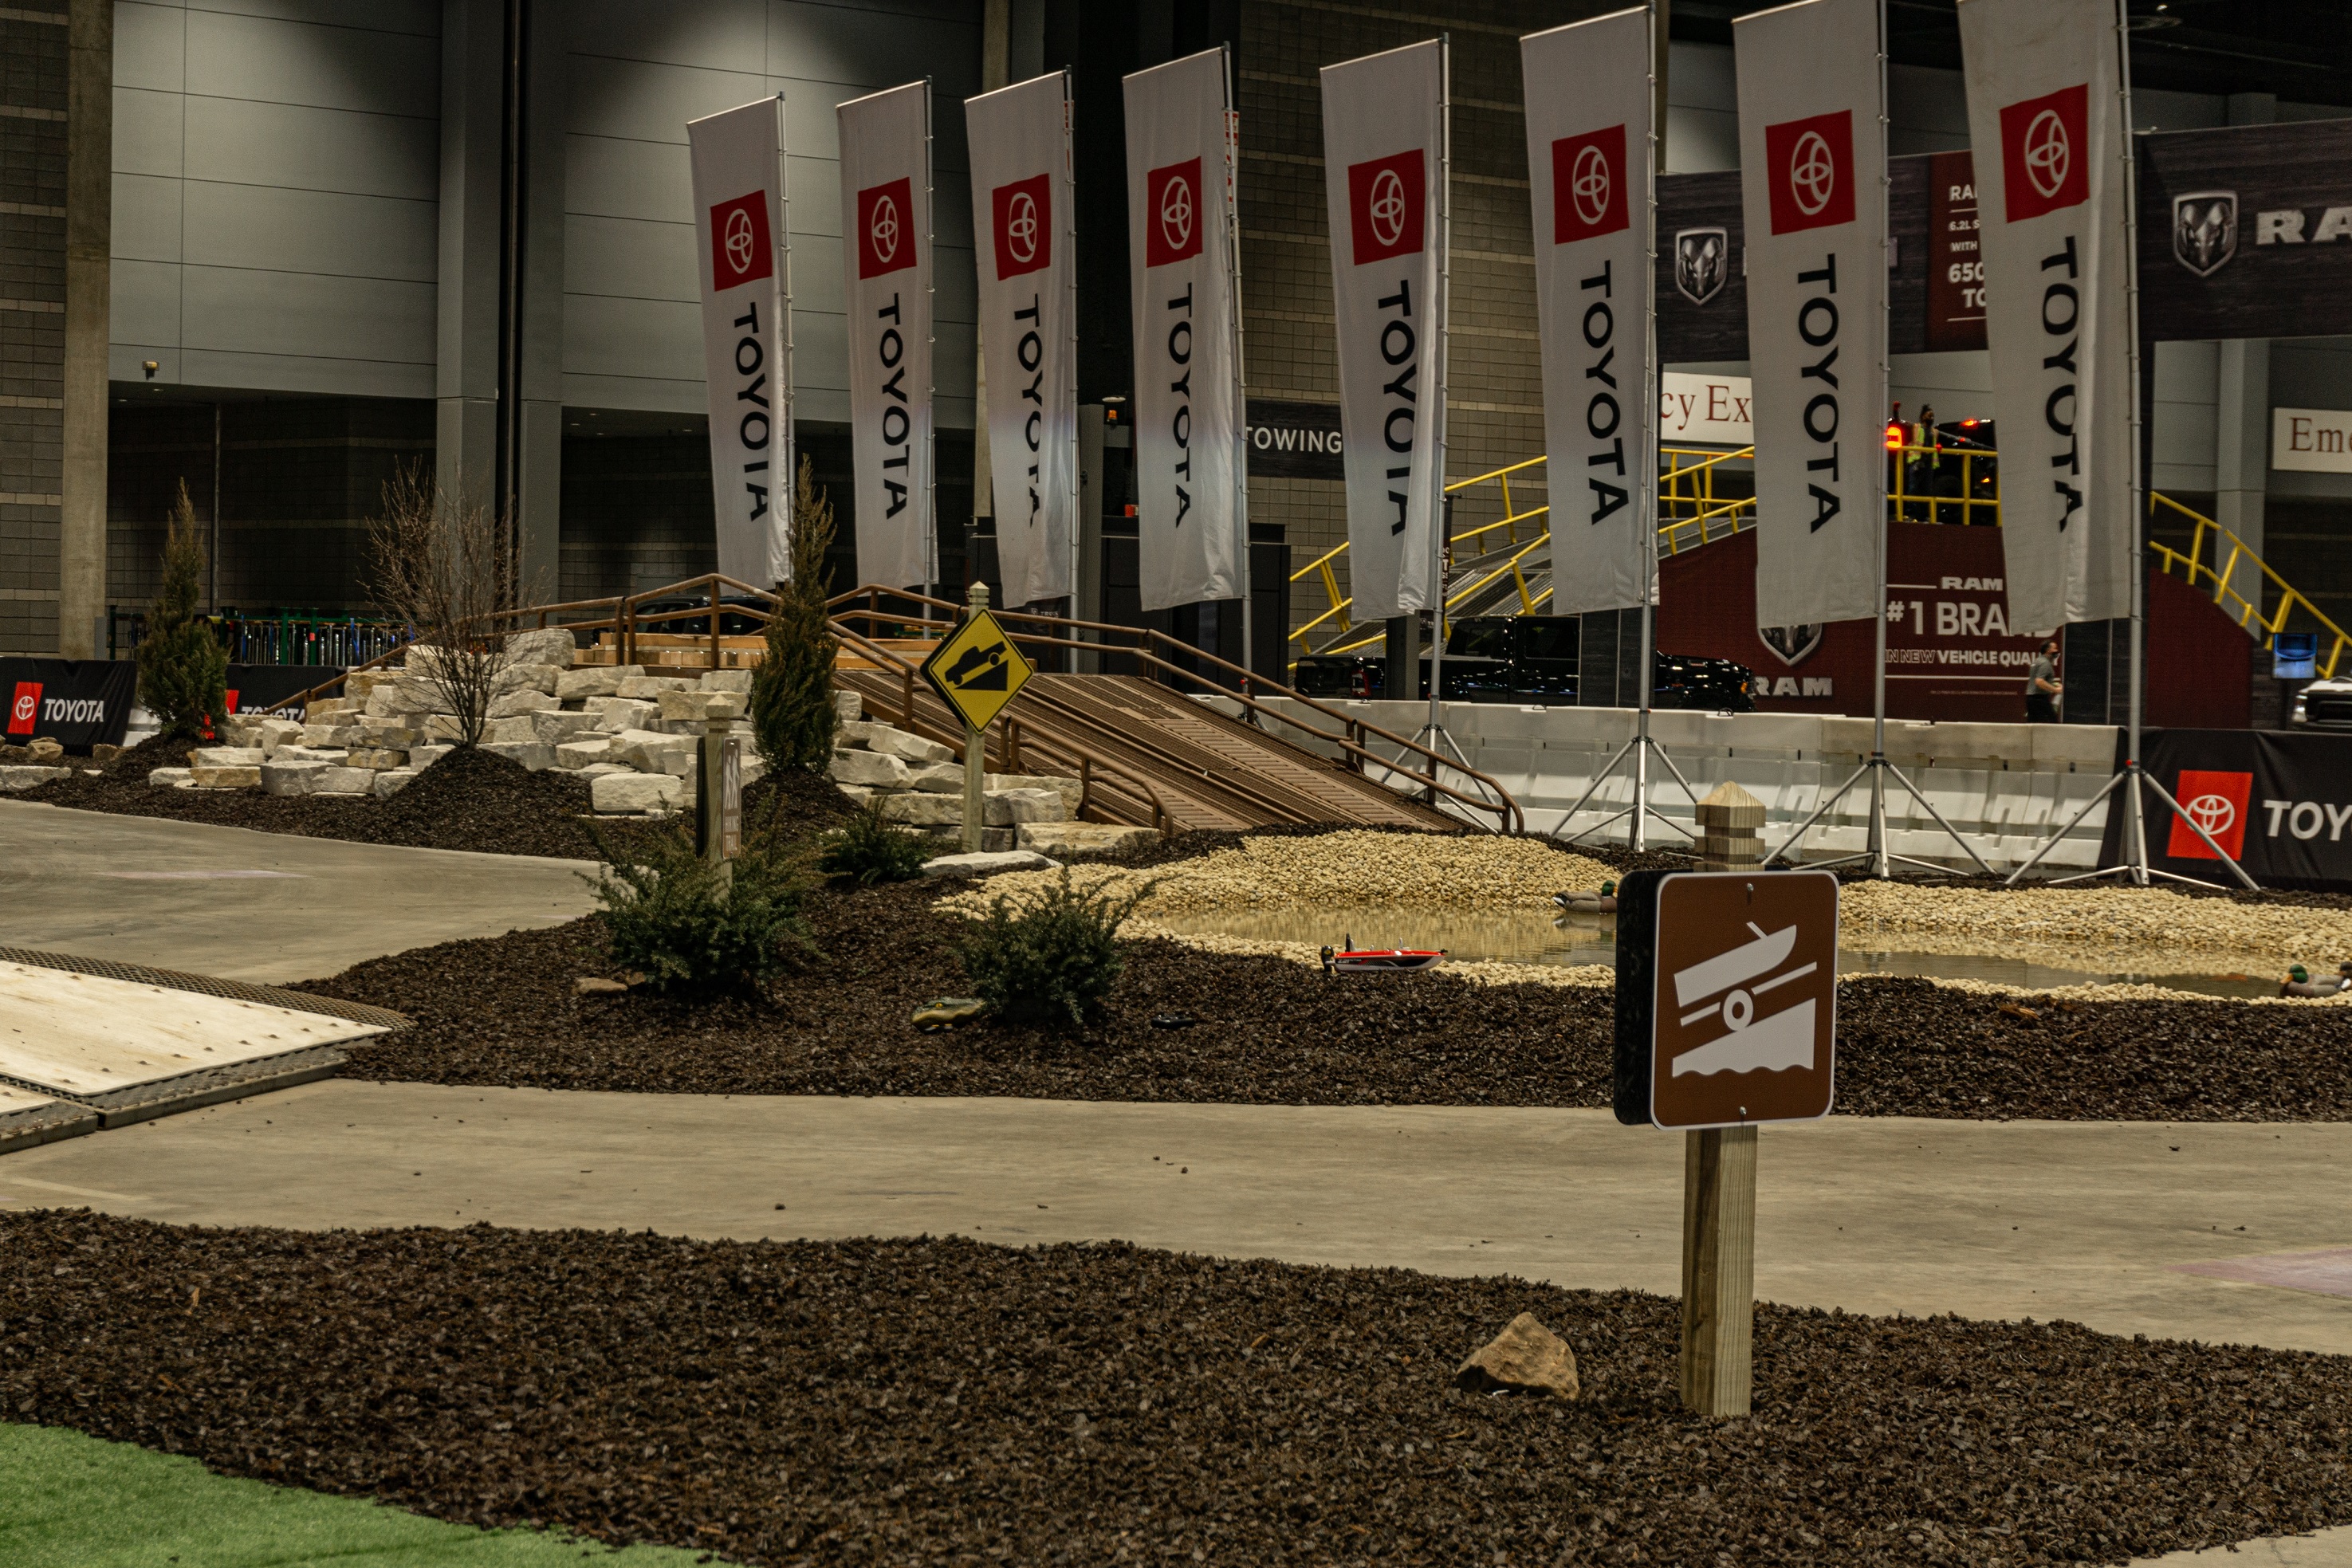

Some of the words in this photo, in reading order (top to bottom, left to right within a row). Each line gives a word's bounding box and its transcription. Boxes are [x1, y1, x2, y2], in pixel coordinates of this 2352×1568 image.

[1949, 184, 1977, 201] RA
[1951, 241, 1977, 252] WITH
[1580, 260, 1629, 525] TOYOTA
[1797, 253, 1841, 533] TOYOTA
[2040, 236, 2083, 532] TOYOTA
[878, 292, 911, 520] TOYOTA
[1167, 282, 1193, 529] TOYOTA
[1705, 384, 1752, 422] Ex
[1941, 576, 2004, 591] RAM
[1936, 601, 2057, 638] BRA
[1900, 649, 1937, 663] NEW
[1937, 650, 1998, 665] VEHICLE
[44, 698, 104, 722] TOYOTA
